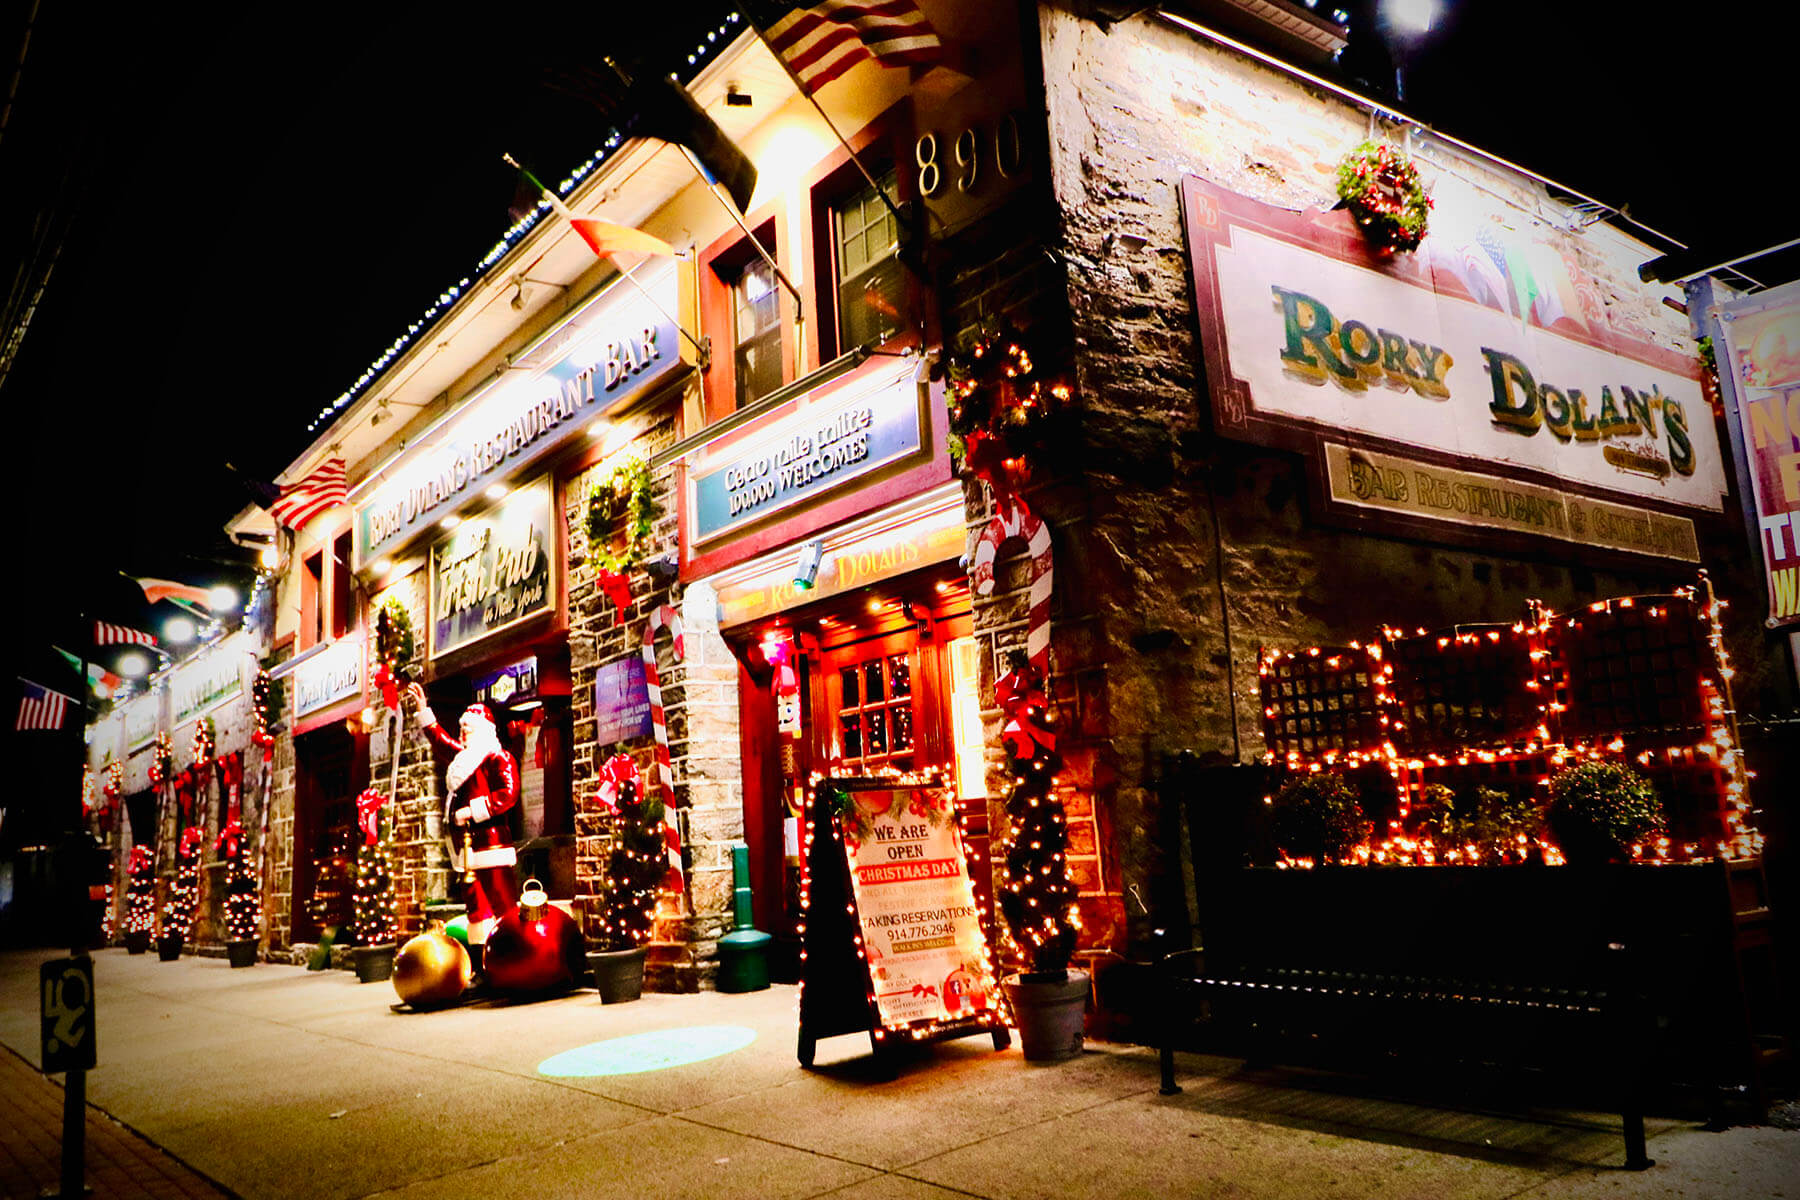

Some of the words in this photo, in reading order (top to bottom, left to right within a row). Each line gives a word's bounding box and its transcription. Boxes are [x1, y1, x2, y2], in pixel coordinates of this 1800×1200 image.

[915, 116, 1020, 196] 890
[1271, 284, 1454, 400] RORY
[1481, 343, 1697, 478] DOLAN'S
[369, 501, 403, 550] RORY
[470, 363, 598, 481] RESTAURANT
[604, 324, 661, 392] BAR
[729, 480, 777, 517] 100,000
[778, 433, 872, 492] WELCOMES
[1347, 457, 1408, 504] BAR
[1415, 469, 1564, 529] RESTAURANT
[1571, 506, 1587, 534] &
[489, 523, 538, 598] Pub
[873, 825, 897, 841] WE
[900, 823, 929, 838] ARE
[887, 844, 924, 860] OPEN
[858, 864, 930, 882] CHRISTMAS
[932, 861, 959, 875] DAY
[862, 913, 901, 929] TAKING
[901, 905, 976, 924] RESERVATIONS
[887, 923, 956, 941] 914.776.2946
